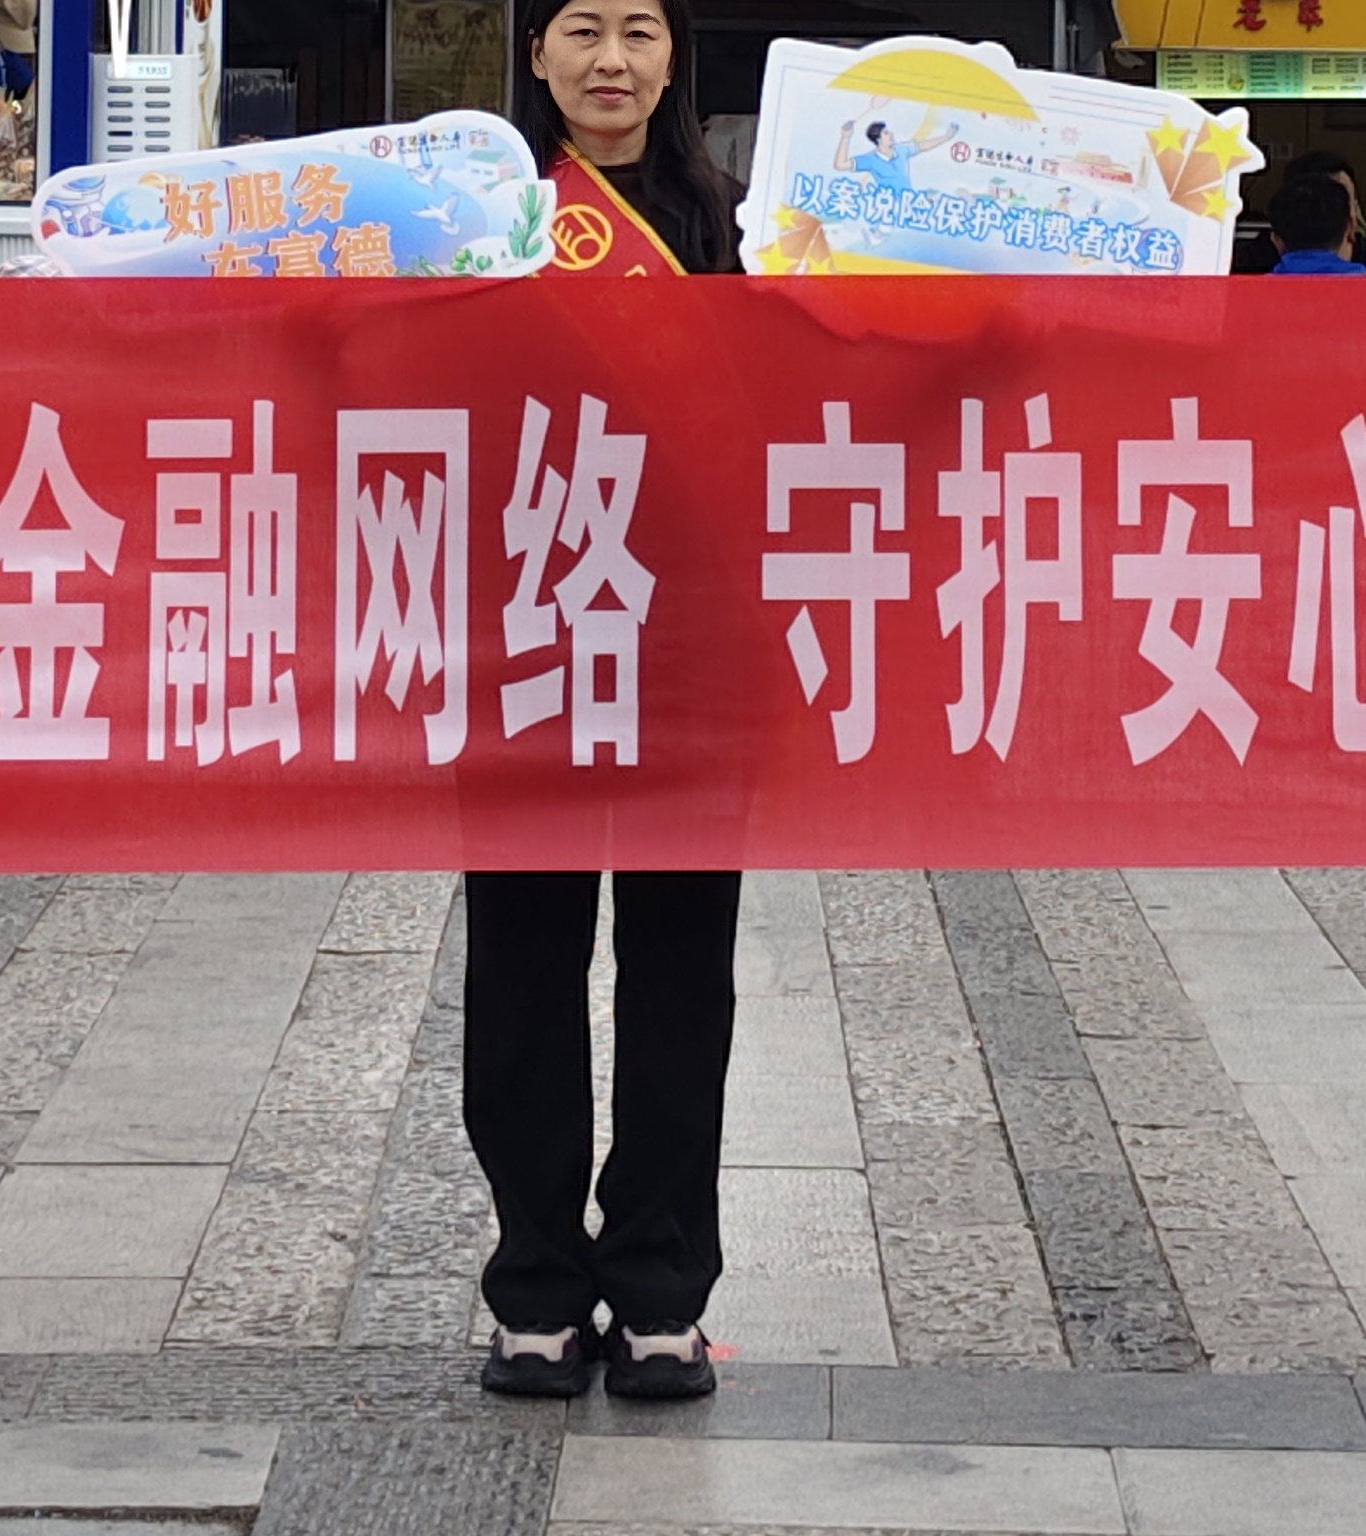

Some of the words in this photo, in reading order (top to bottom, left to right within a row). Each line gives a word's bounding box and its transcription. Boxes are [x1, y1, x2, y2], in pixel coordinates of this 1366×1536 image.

[161, 164, 352, 243] 好服务
[790, 172, 1183, 271] 以案说险保护消费者权益
